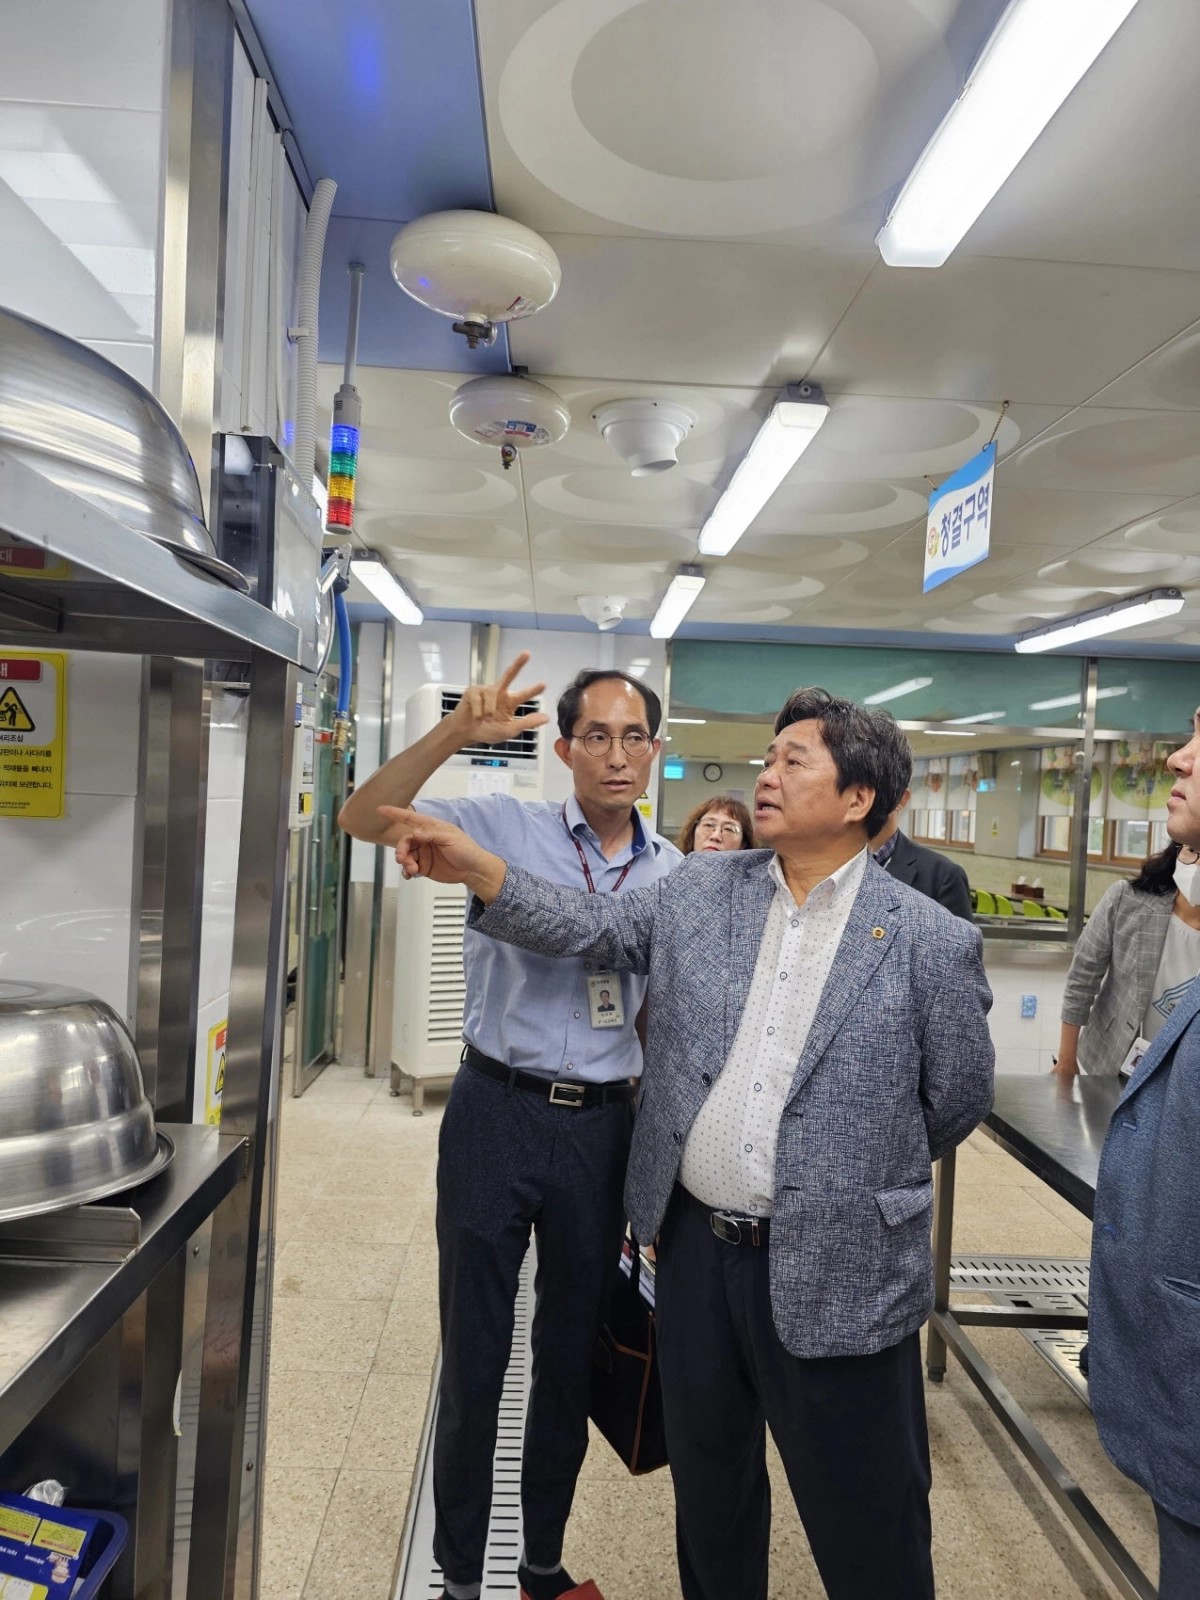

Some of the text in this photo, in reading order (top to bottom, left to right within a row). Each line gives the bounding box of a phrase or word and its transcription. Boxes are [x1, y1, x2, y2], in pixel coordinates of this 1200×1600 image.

[941, 482, 990, 557] 청결구역
[25, 749, 52, 758] 사다리를
[32, 765, 52, 773] 빼내지
